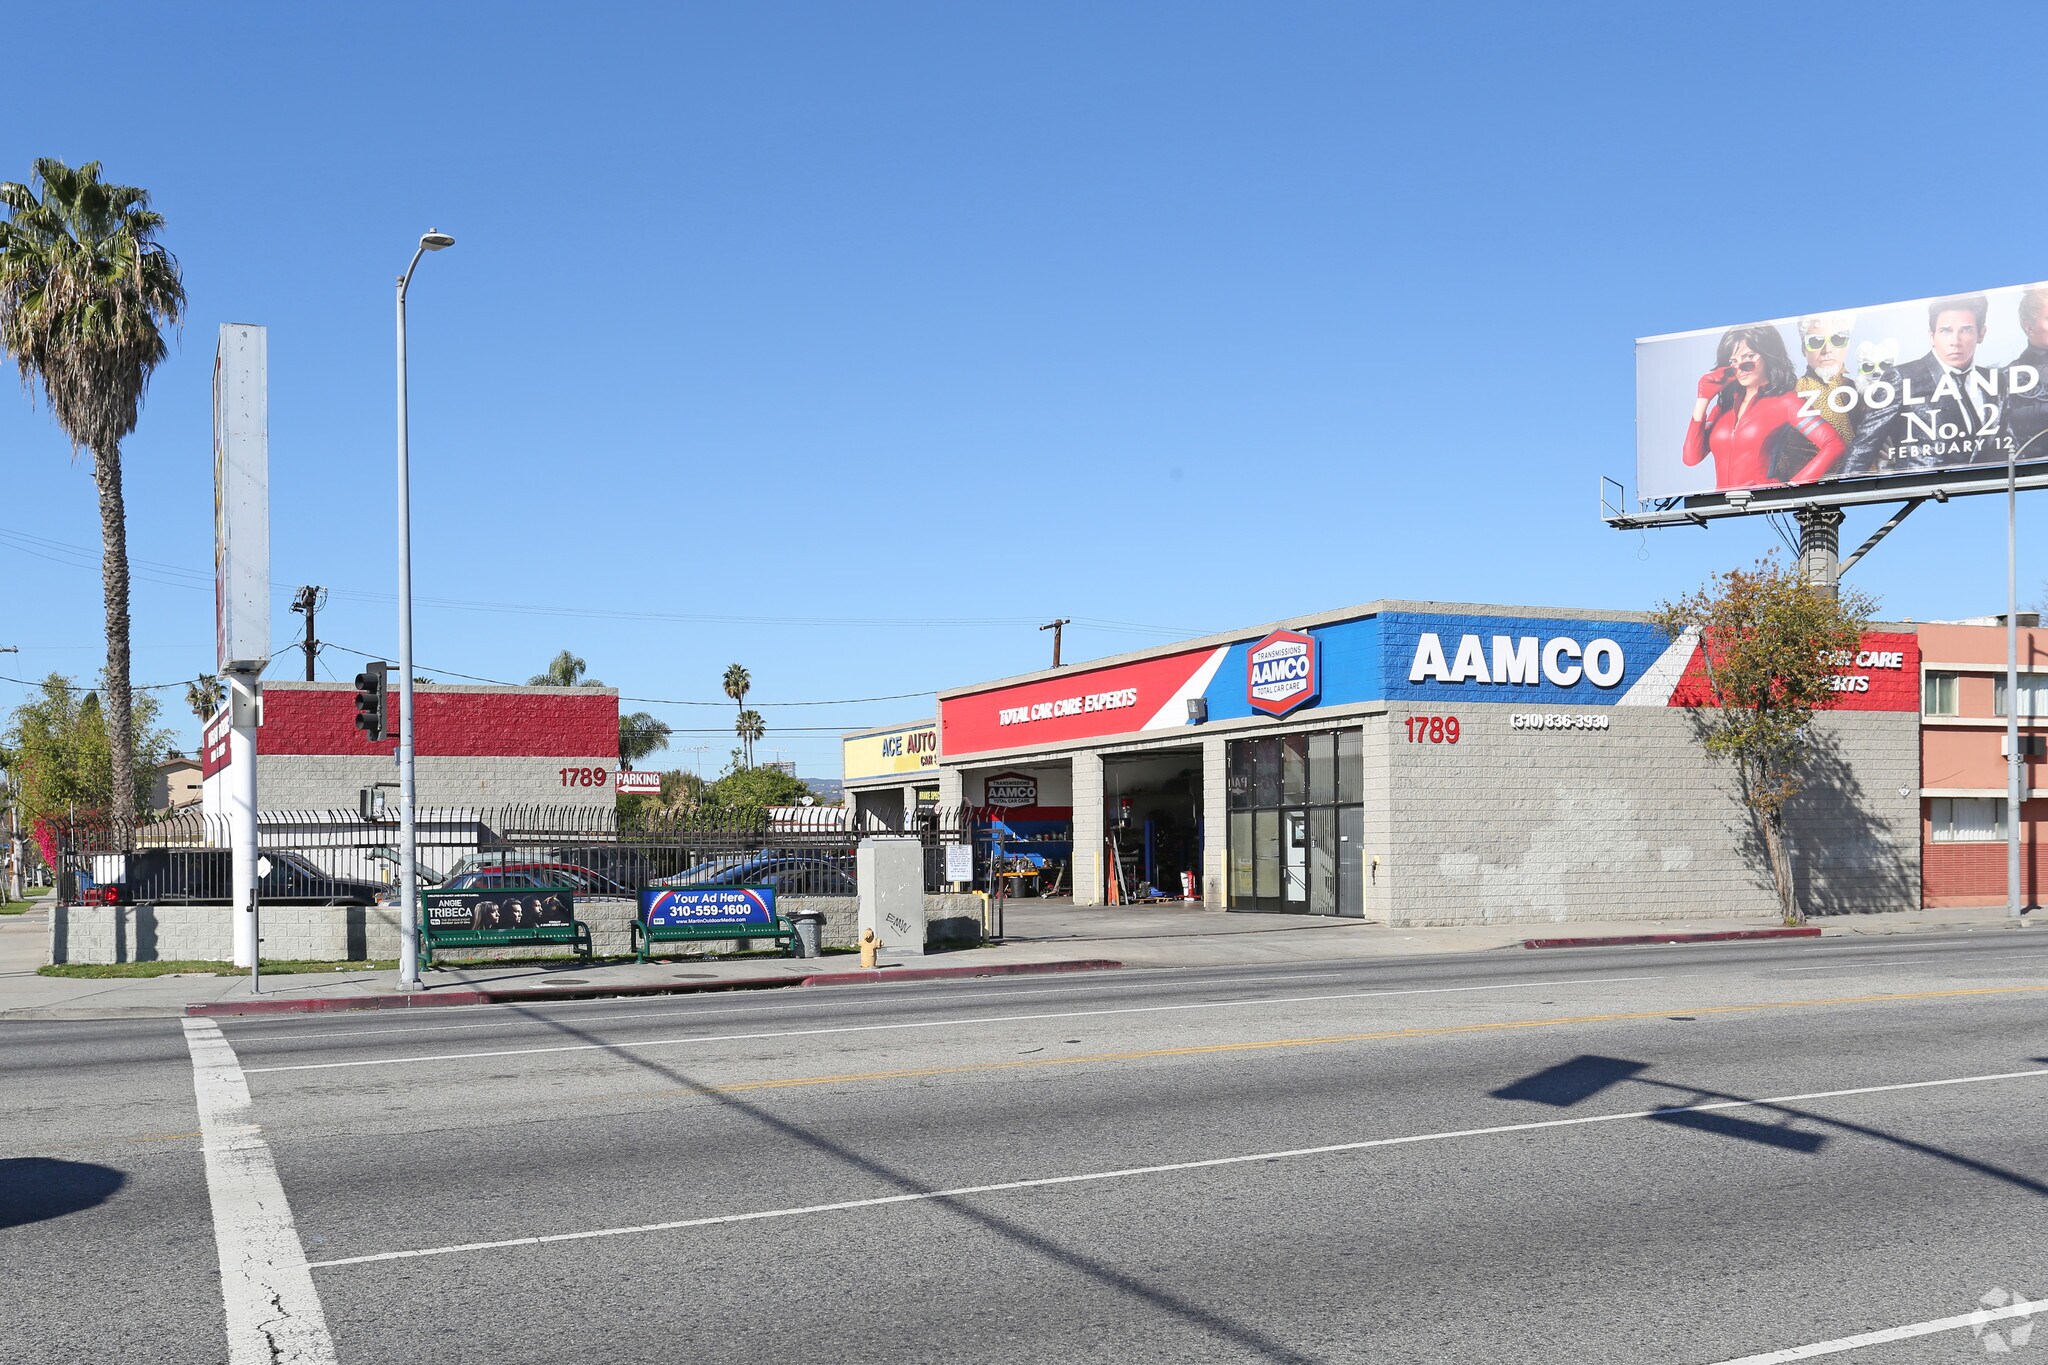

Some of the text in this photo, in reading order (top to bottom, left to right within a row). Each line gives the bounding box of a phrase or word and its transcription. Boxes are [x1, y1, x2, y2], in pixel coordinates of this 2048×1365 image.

[1796, 365, 2040, 418] ZOOLAND
[1901, 403, 2000, 444] No. 2
[1888, 437, 2013, 460] FEBRUARY 12
[1258, 646, 1302, 660] TRANSMISSIONS
[1408, 632, 1625, 688] AAMCO
[1856, 651, 1904, 669] CARE
[1250, 655, 1310, 685] AAMCO
[1258, 682, 1300, 695] TOTAL CAR CARE
[999, 688, 1137, 726] TOTAL CAR CARE EXPERTS
[1405, 716, 1460, 744] 1789
[1510, 713, 1609, 731] (310) 836-3930
[882, 731, 936, 757] ACE AUTO
[920, 755, 933, 767] CAR
[559, 767, 607, 787] 1789
[616, 773, 660, 785] PARKING
[988, 787, 1036, 798] AAMCO
[438, 899, 462, 907] ANGIE
[673, 893, 745, 904] Your Ad Here
[428, 907, 473, 918] TRIBECA
[669, 904, 751, 917] 310-559-1600
